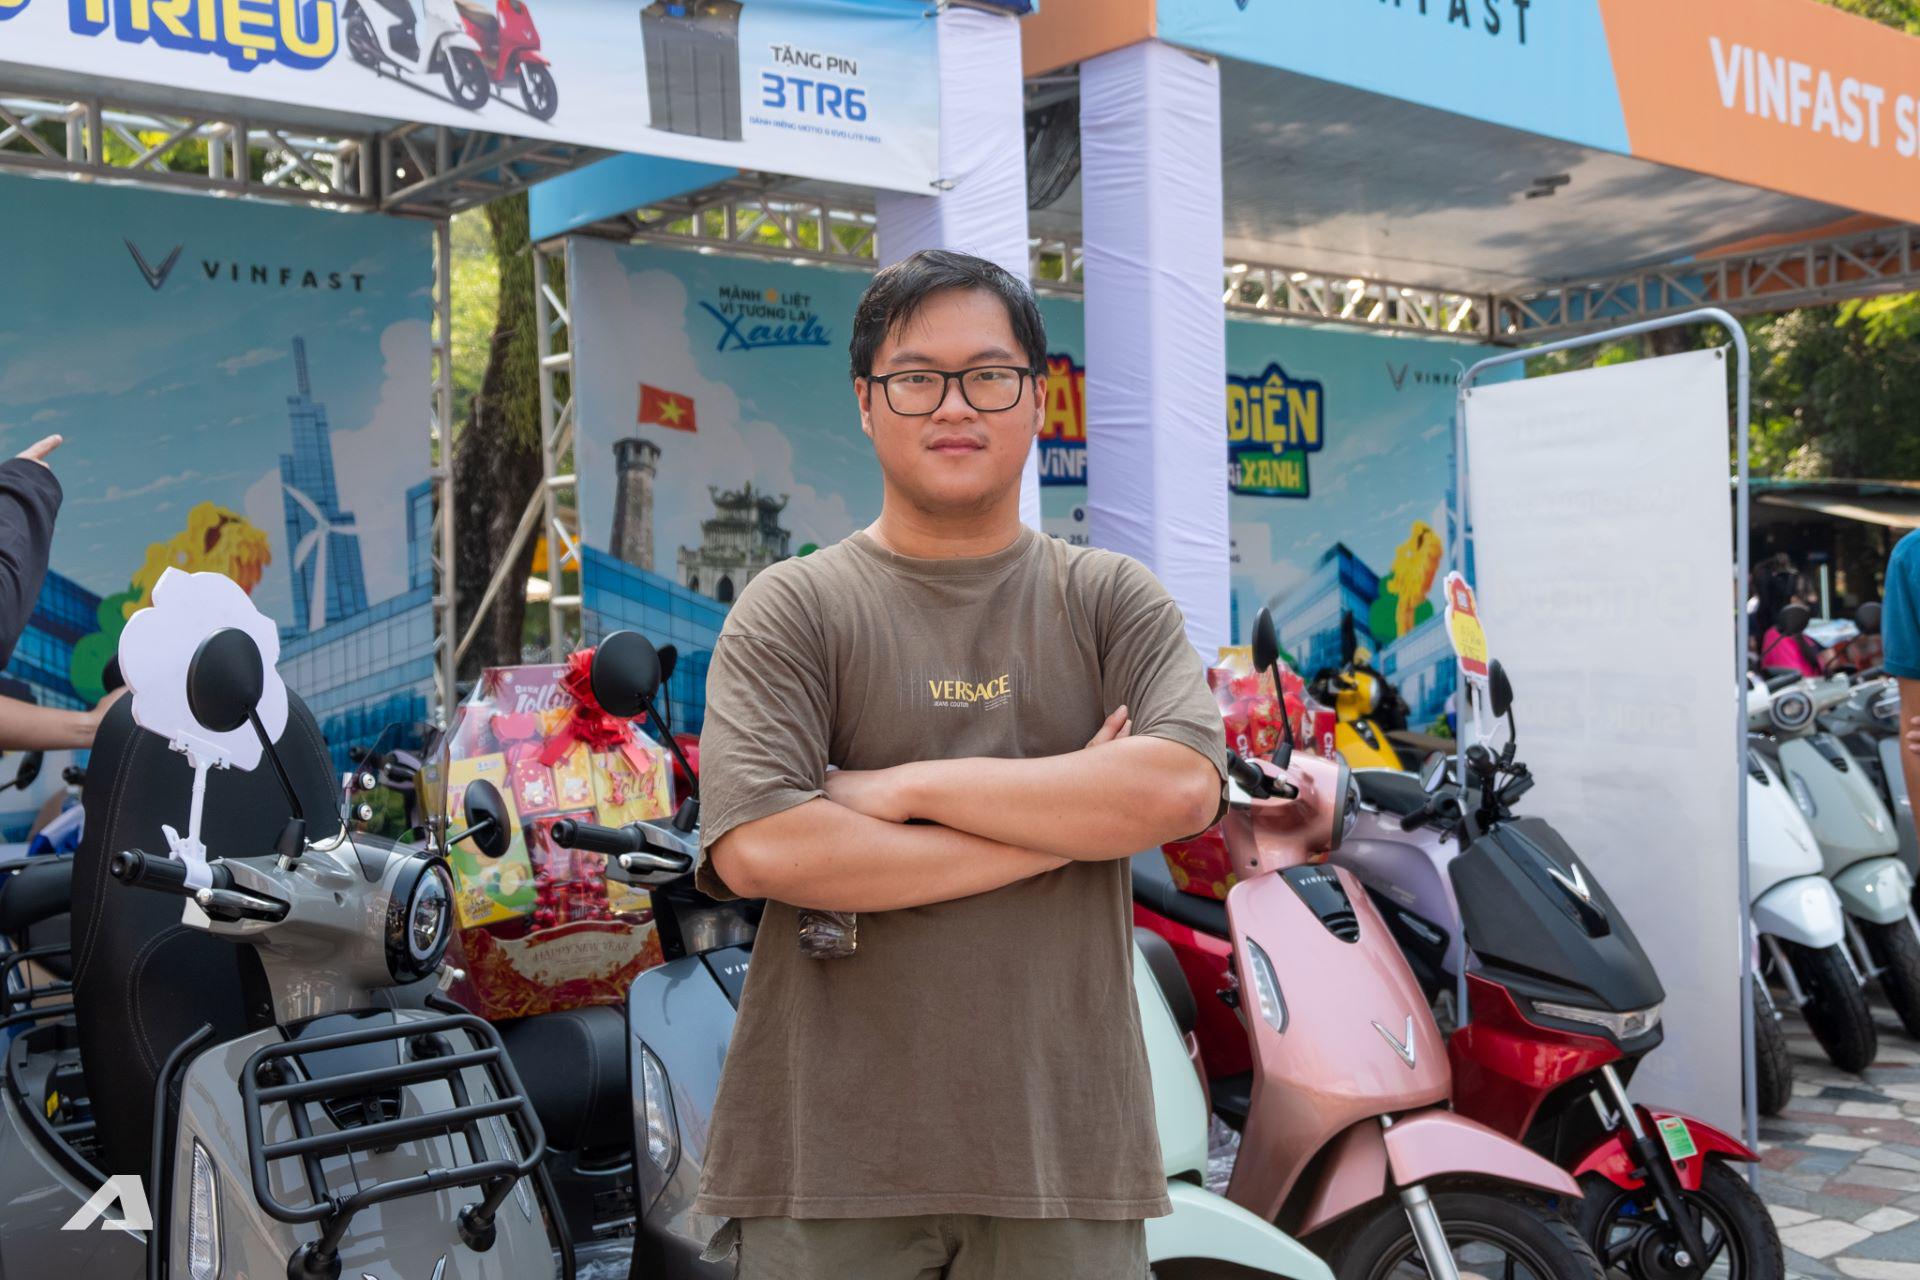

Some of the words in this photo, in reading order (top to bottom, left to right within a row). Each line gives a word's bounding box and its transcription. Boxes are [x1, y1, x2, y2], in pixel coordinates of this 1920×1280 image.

[826, 56, 858, 76] PIN
[762, 72, 867, 122] 3TR6
[1709, 36, 1885, 148] VINFAST
[1894, 93, 1920, 160] S
[203, 260, 366, 293] VINFAST
[782, 290, 812, 310] LIỆT
[1243, 459, 1301, 489] XANH
[928, 674, 1011, 702] VERSACE
[533, 944, 572, 961] HAPPY
[575, 942, 600, 953] NEW
[601, 941, 630, 953] YEAR
